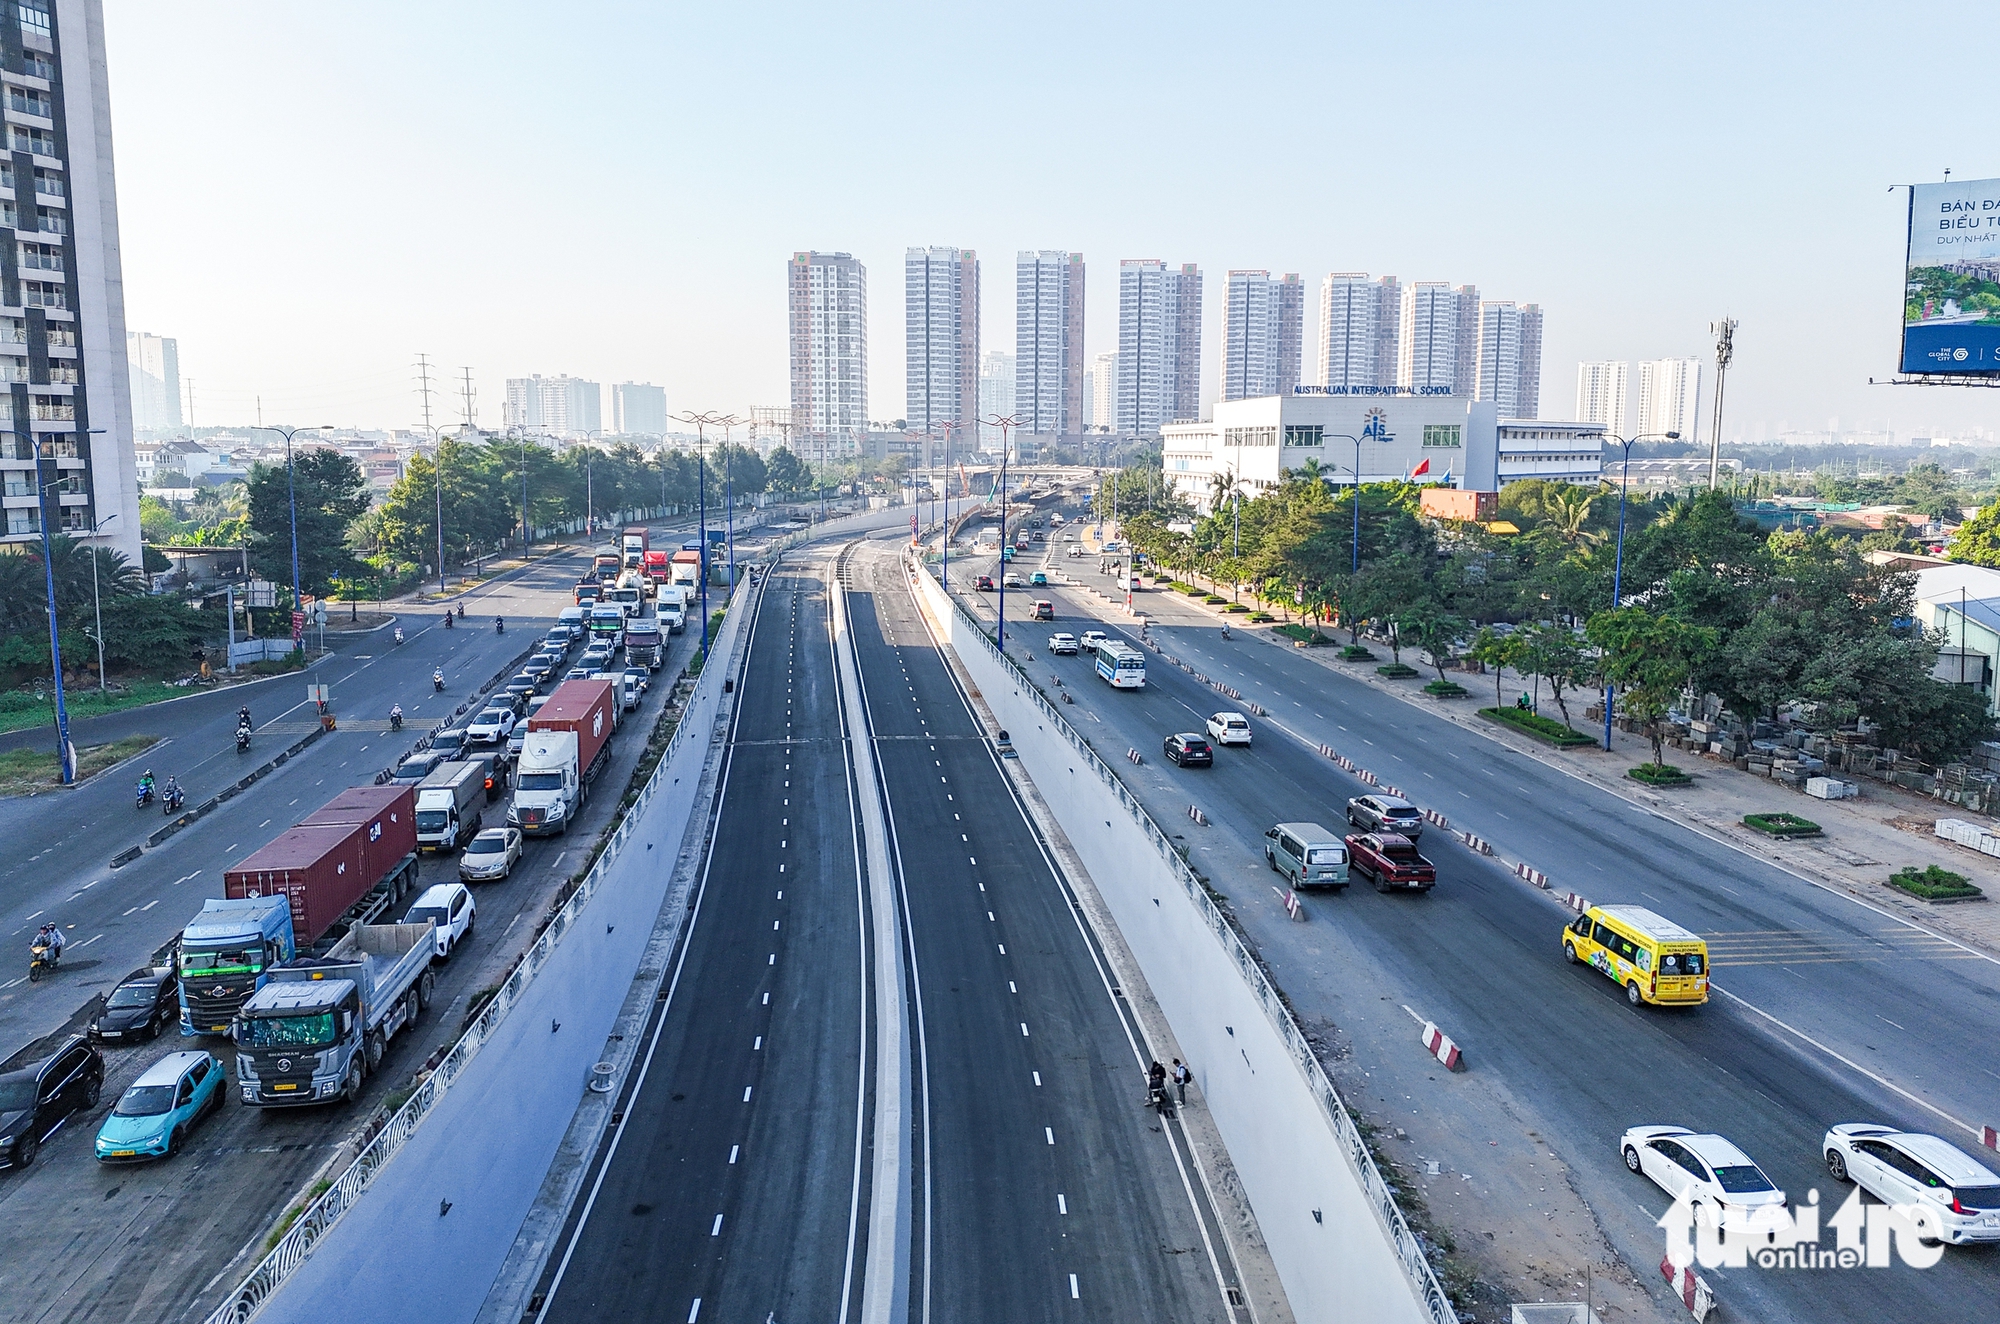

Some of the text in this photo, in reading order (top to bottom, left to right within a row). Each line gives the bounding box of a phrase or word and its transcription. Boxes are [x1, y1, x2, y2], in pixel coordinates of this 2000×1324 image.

[1941, 199, 1976, 213] BÁN
[1939, 214, 1980, 230] BIỂU
[1937, 232, 1998, 245] DUY NHẤT
[1294, 385, 1453, 395] AUSTRALIAN INTERNATIONAL SCHOOL
